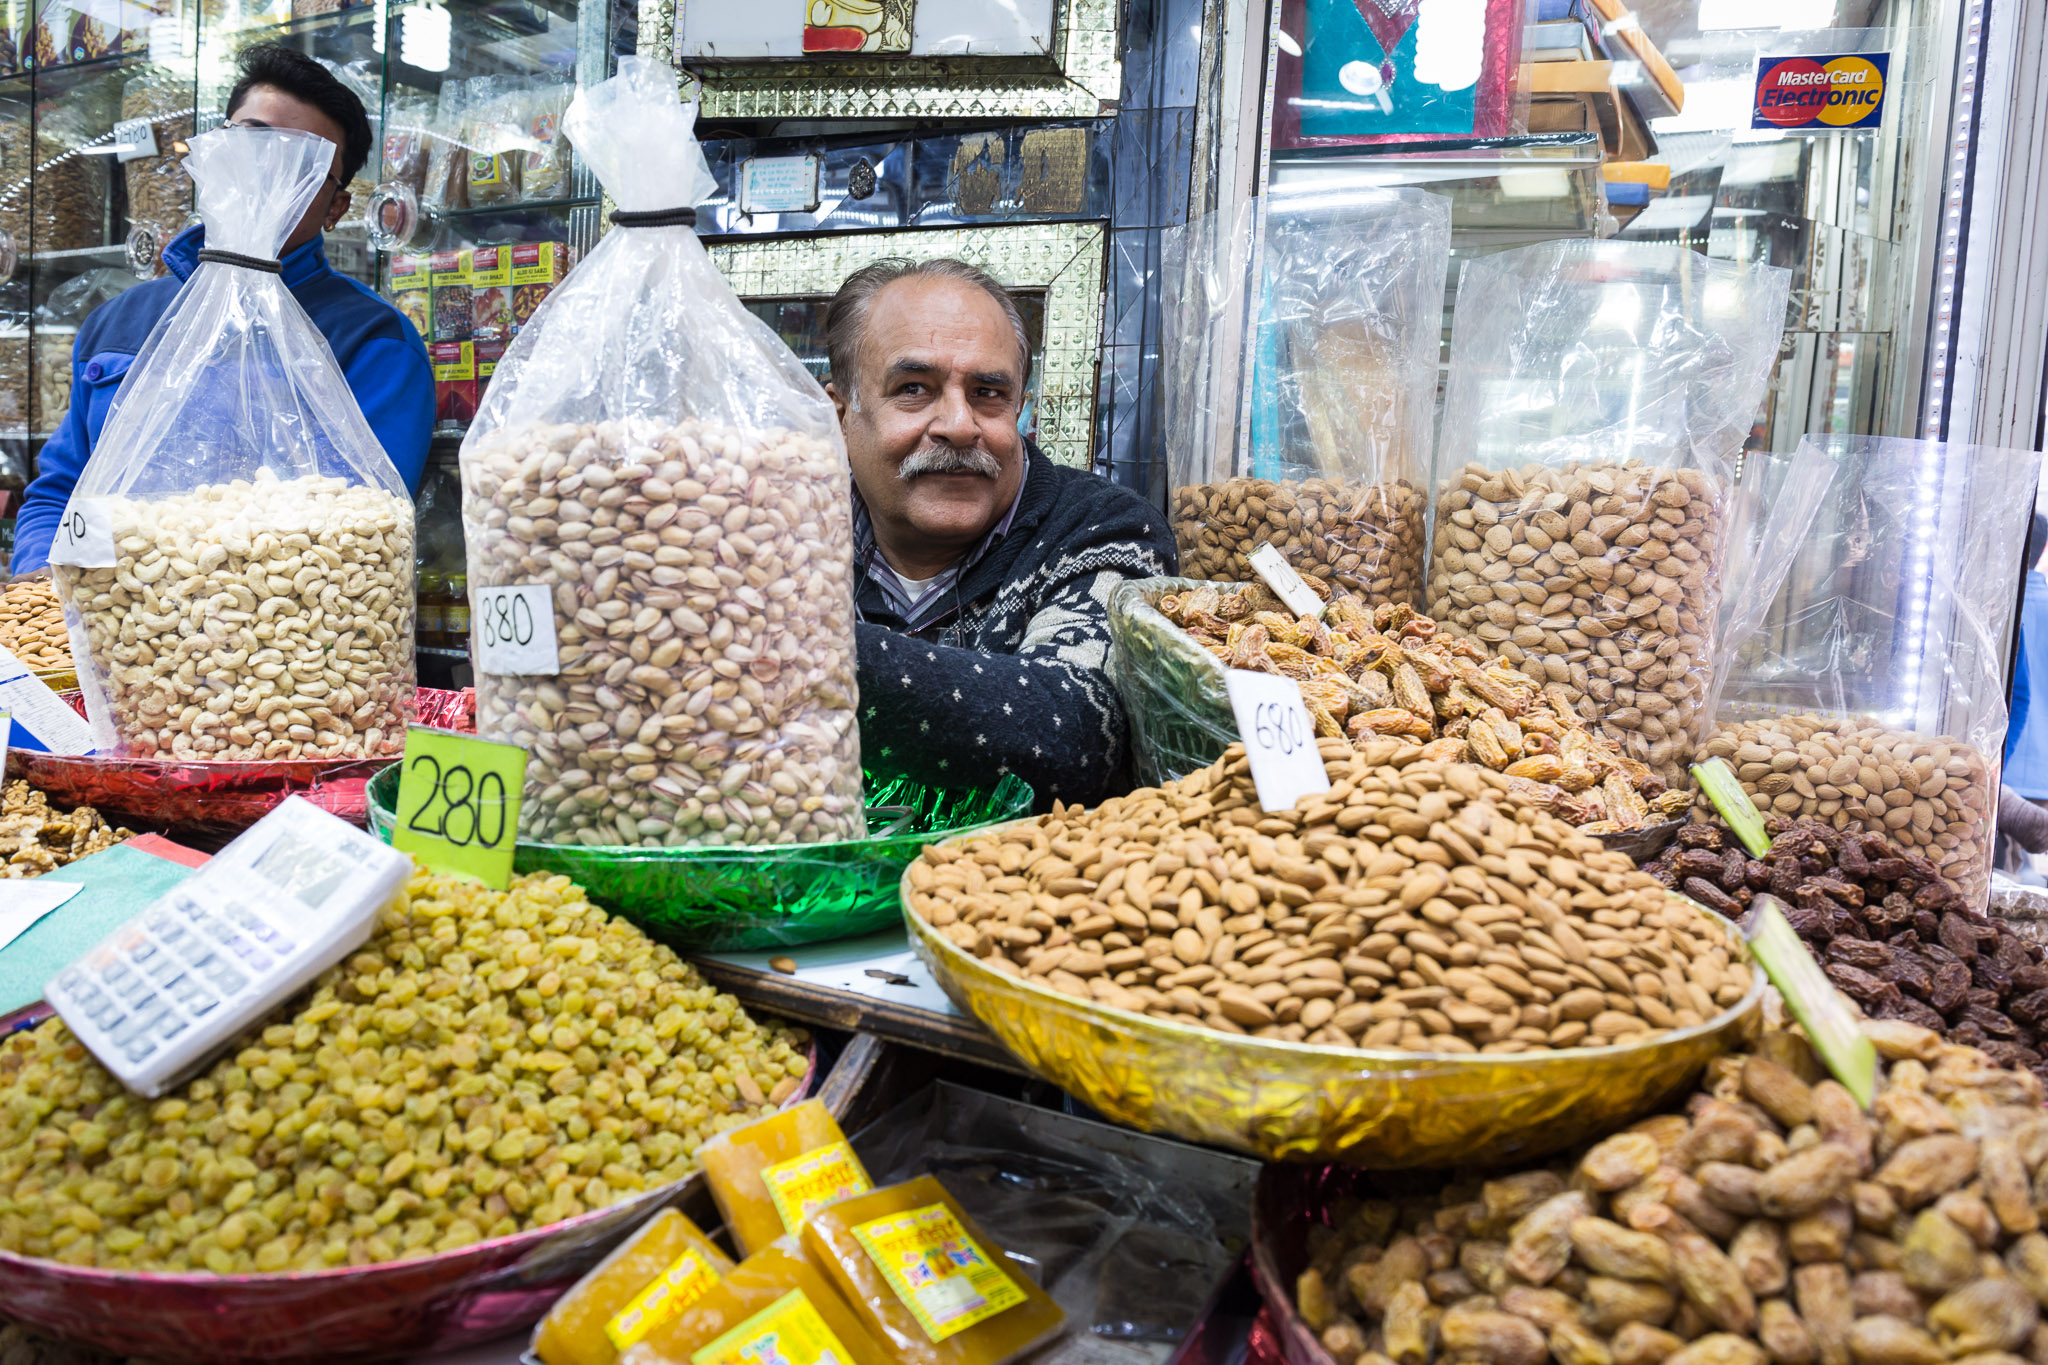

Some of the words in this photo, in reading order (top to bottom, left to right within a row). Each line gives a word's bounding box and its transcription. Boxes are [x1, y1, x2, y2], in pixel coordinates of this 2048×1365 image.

[1761, 88, 1880, 107] Electronic
[1777, 69, 1869, 86] MasterCard
[56, 511, 86, 546] 40
[482, 592, 534, 648] 880
[1255, 702, 1303, 755] 680
[408, 754, 506, 849] 280
